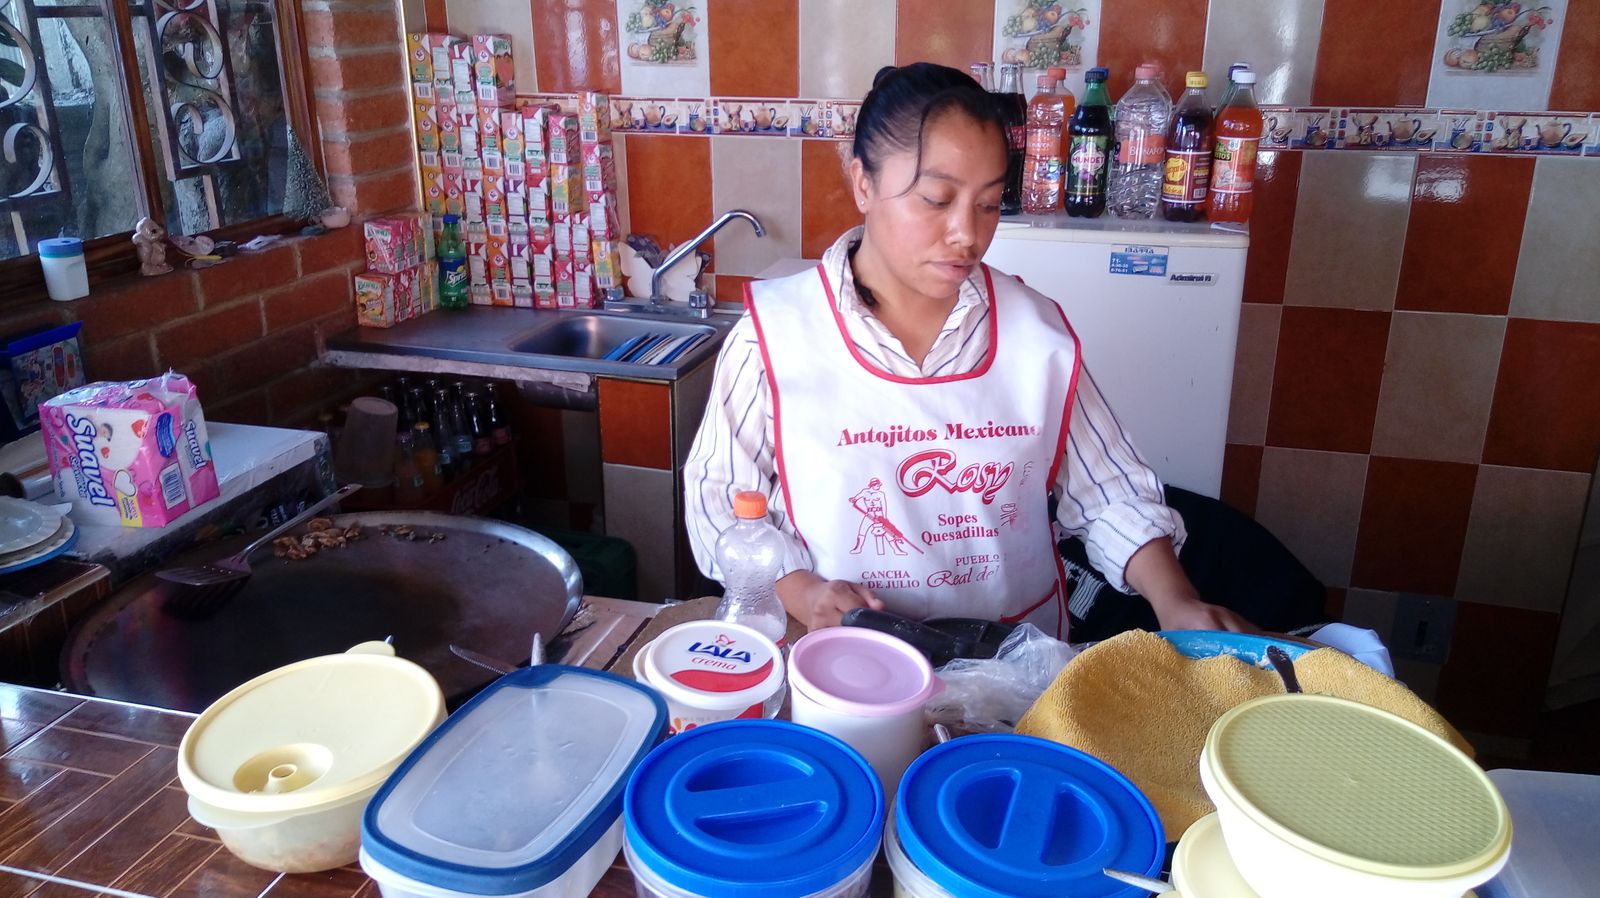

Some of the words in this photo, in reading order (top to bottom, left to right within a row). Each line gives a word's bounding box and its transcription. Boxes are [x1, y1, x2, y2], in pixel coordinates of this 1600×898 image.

[1072, 156, 1105, 164] MUNDET
[181, 418, 207, 470] Suavel
[837, 425, 938, 448] Antojitos
[66, 413, 117, 508] Suavel
[896, 448, 1015, 505] Rosy
[937, 512, 978, 528] Sopes
[921, 526, 1000, 546] Quesadillas
[861, 570, 911, 580] CANCHA
[868, 580, 884, 589] DE
[885, 580, 920, 589] JULIO
[926, 566, 973, 588] Real
[688, 641, 752, 663] LALA
[691, 656, 737, 671] crema
